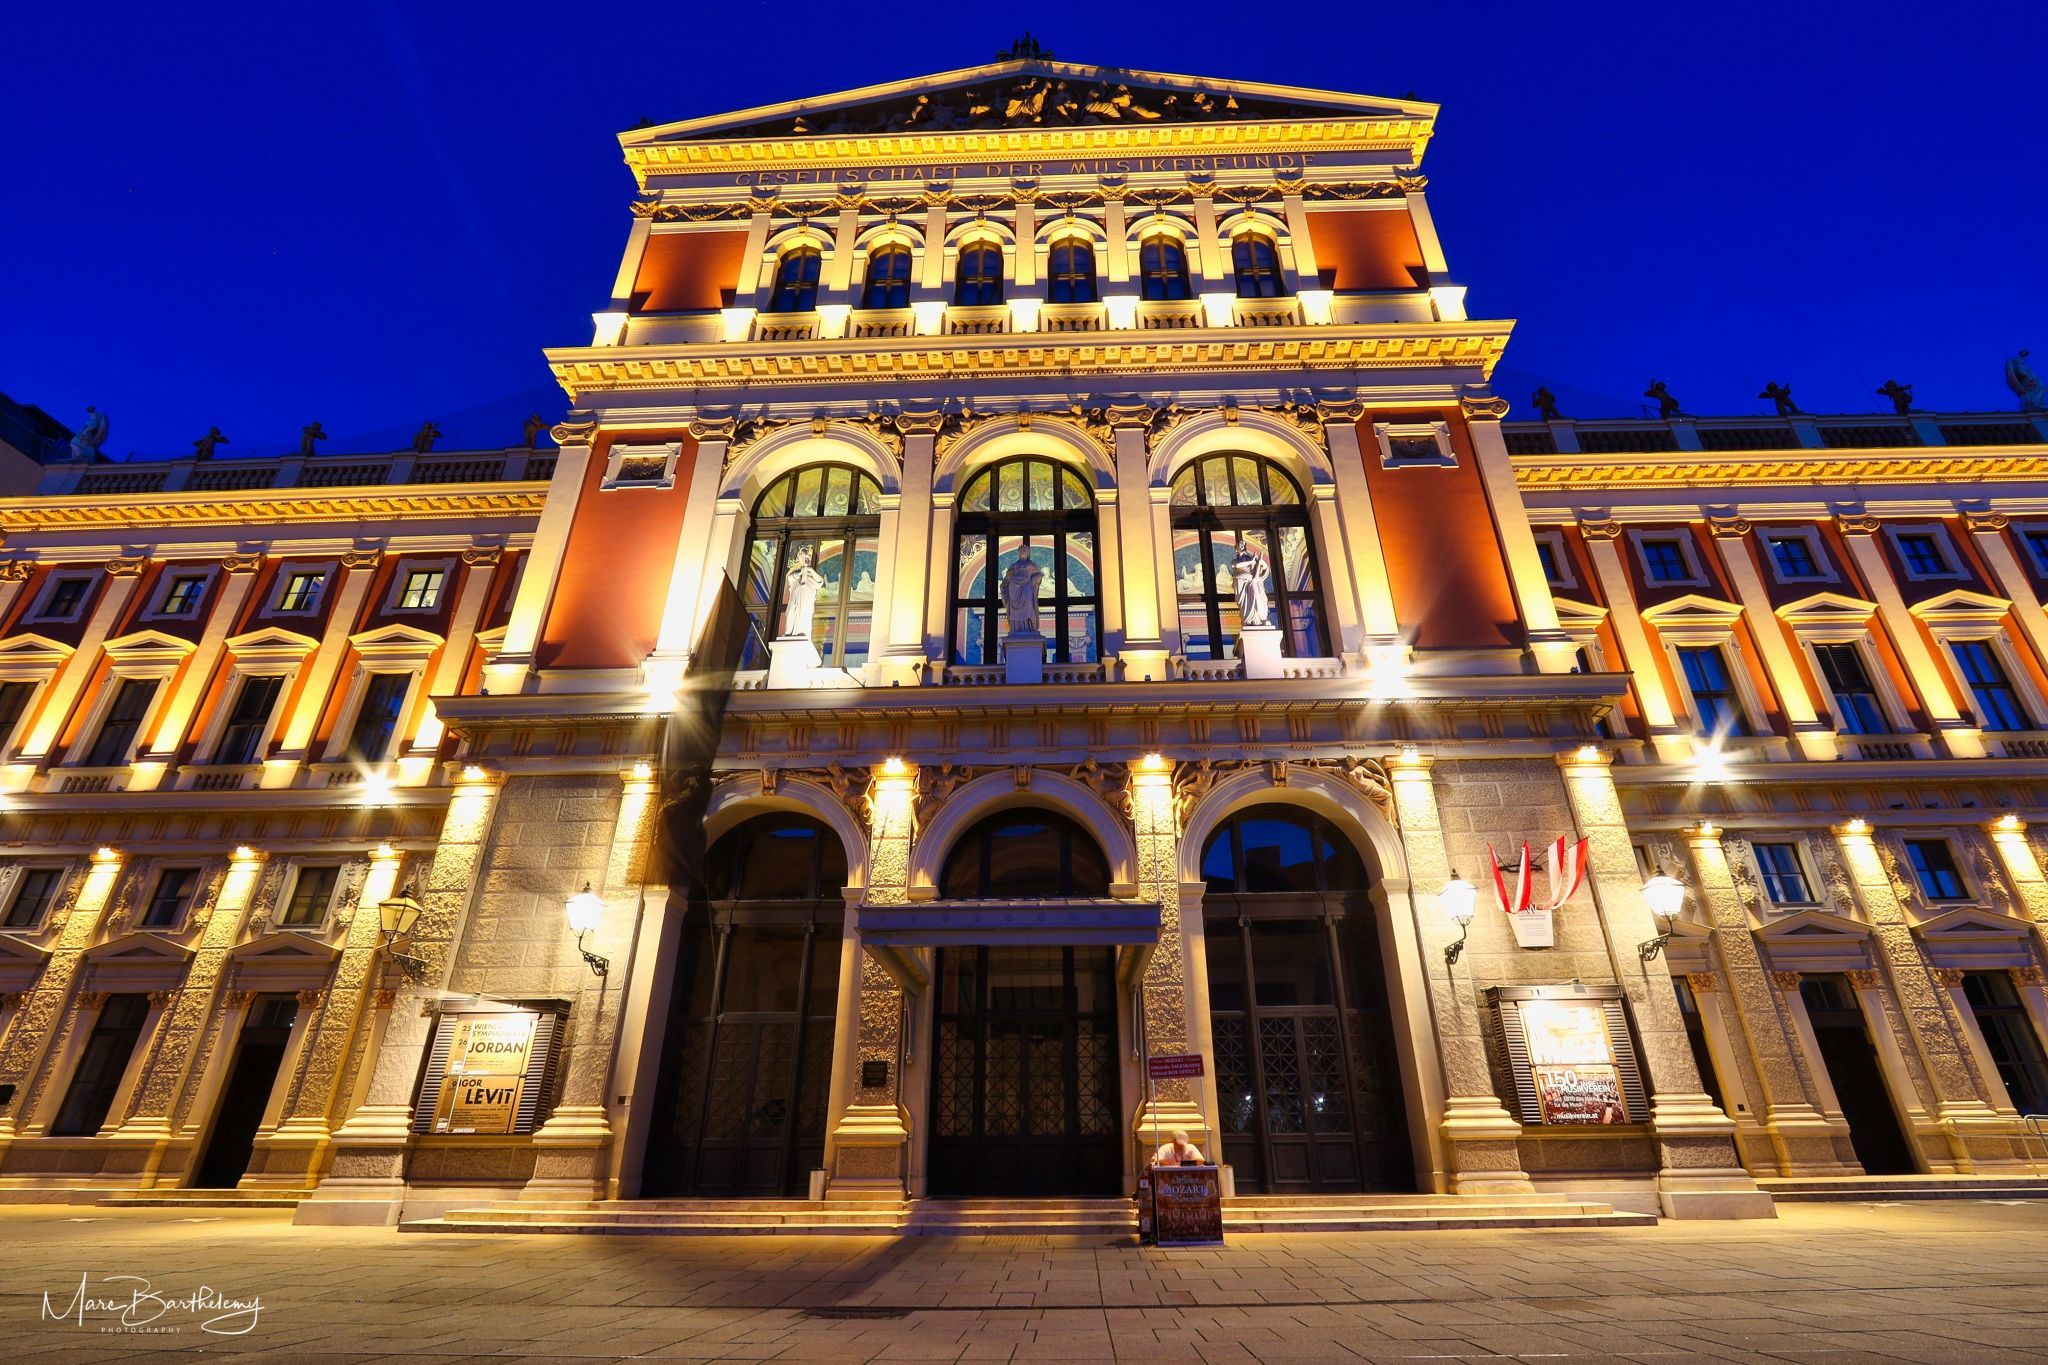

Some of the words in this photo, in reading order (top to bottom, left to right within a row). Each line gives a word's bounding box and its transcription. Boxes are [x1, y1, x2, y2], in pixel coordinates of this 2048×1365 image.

[735, 166, 963, 186] GESELLSCHAFT
[985, 163, 1044, 177] DER
[1070, 154, 1315, 174] MUSIKFREUNDE
[468, 1042, 525, 1054] JORDAN
[459, 1079, 483, 1087] IGOR
[1546, 1070, 1578, 1088] 150
[1560, 1084, 1611, 1093] MUSIKVEREIN
[1556, 1112, 1599, 1120] musikverein.at
[1163, 1185, 1206, 1194] MOZART
